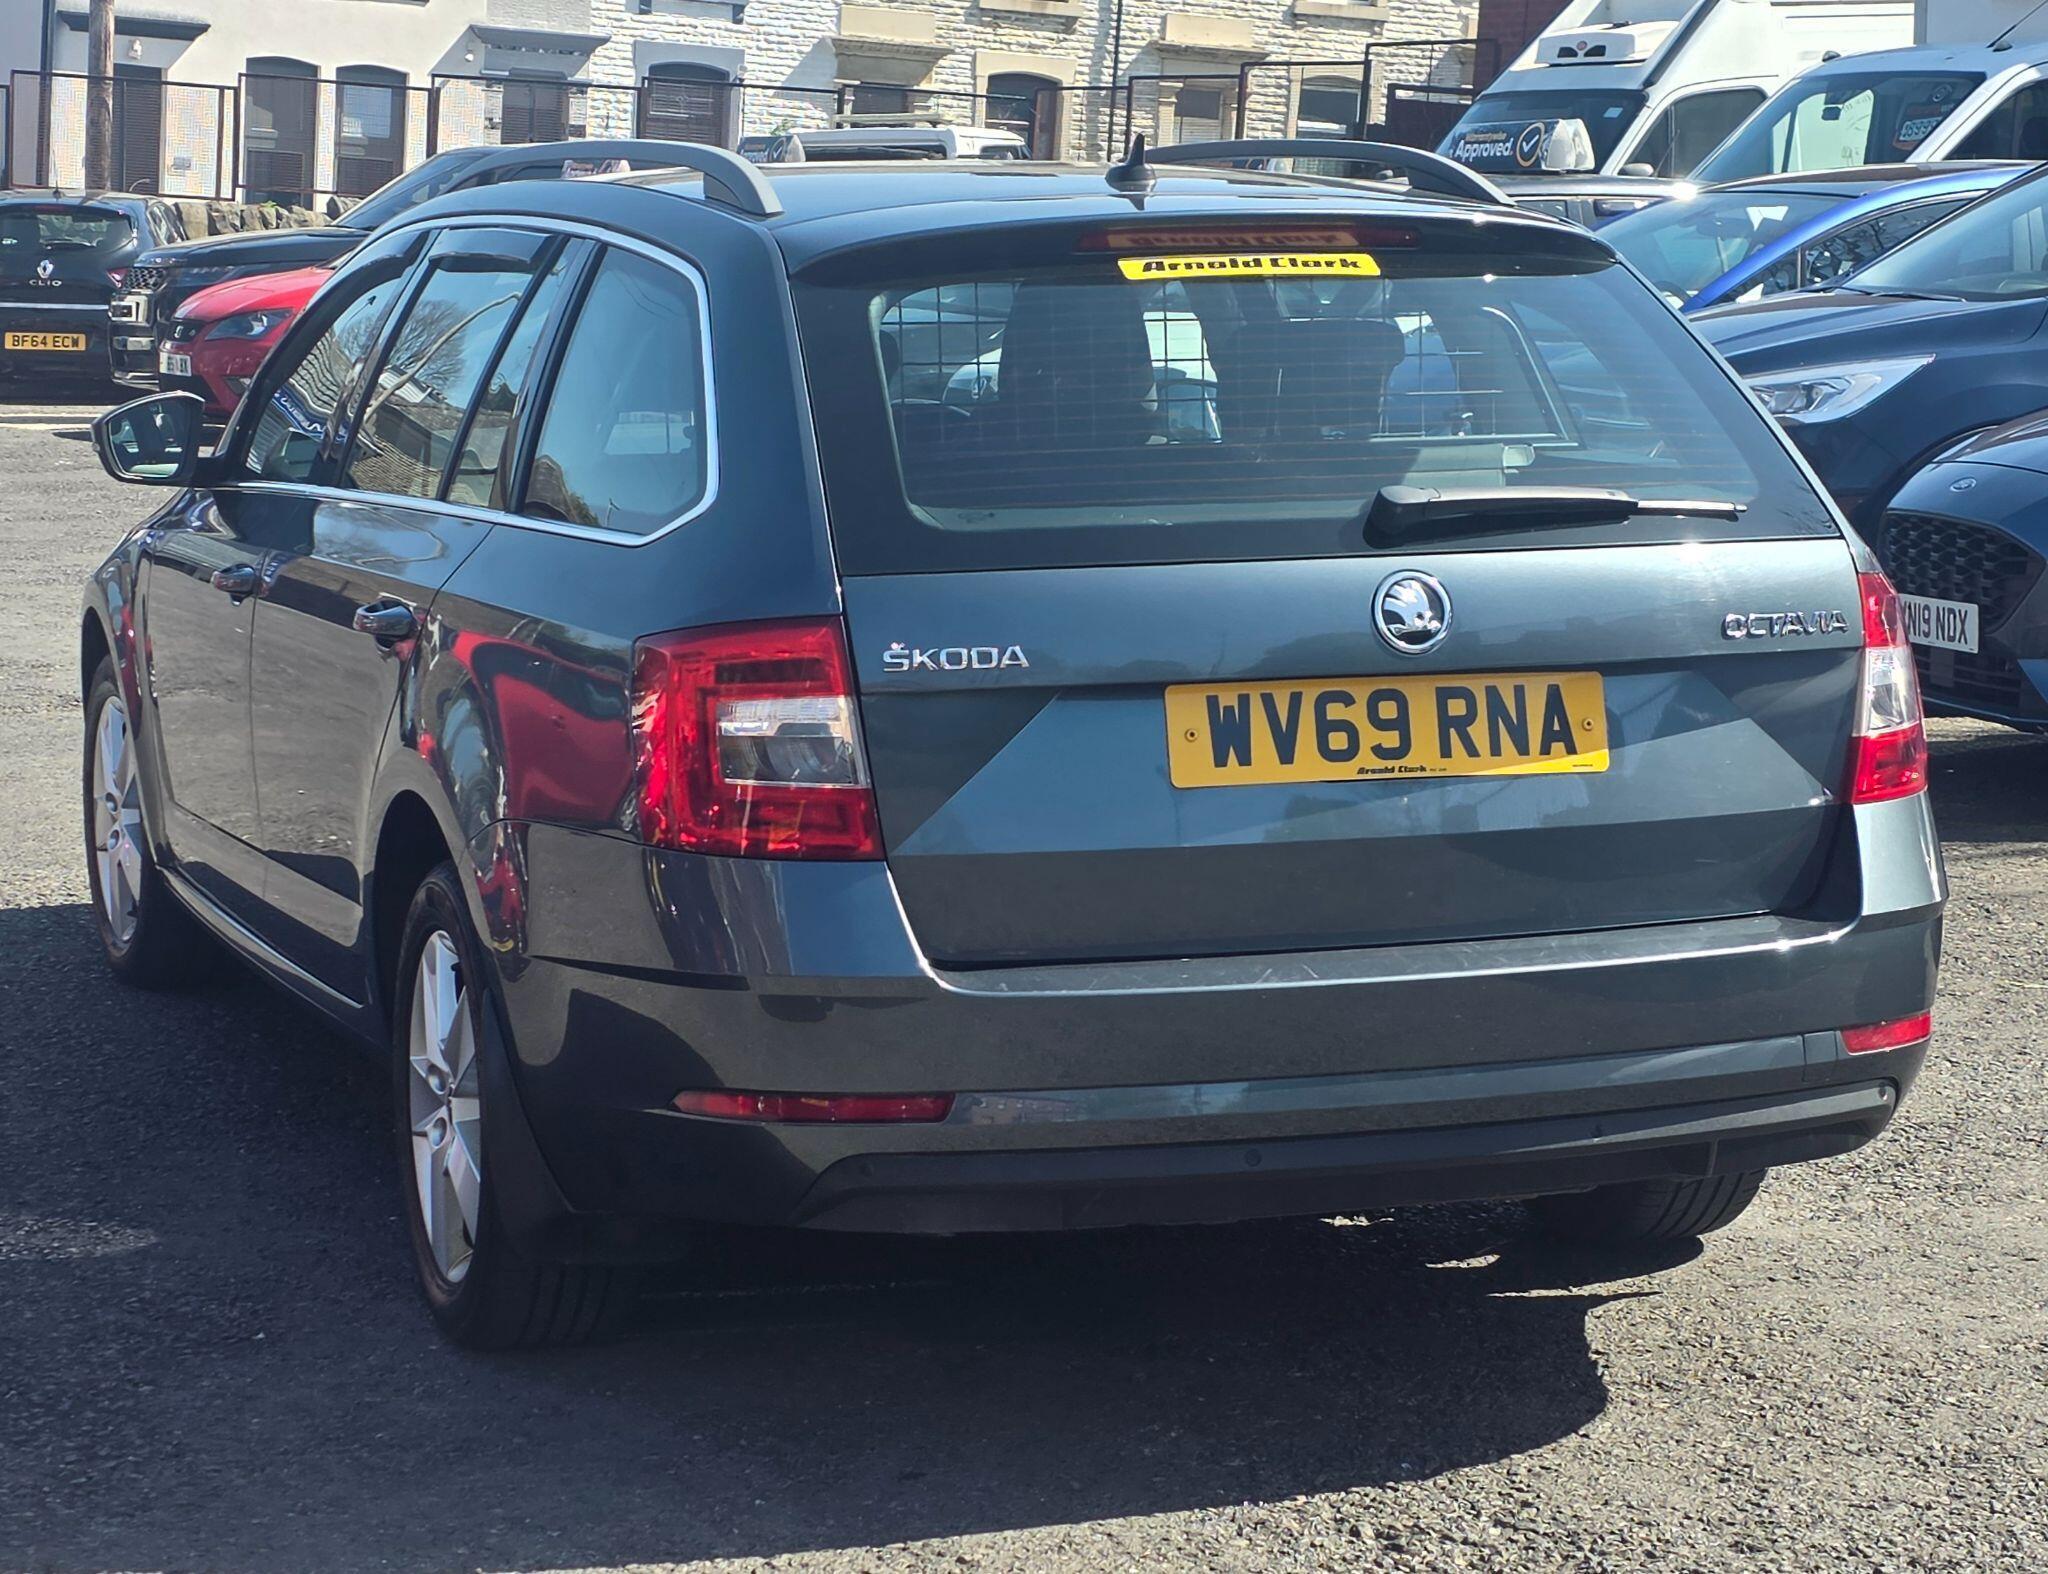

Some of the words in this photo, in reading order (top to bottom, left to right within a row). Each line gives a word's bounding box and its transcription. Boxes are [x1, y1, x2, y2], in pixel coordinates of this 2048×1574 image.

[1142, 257, 1263, 272] Arnold
[1270, 257, 1361, 269] Clark
[29, 279, 62, 287] CLIO
[12, 334, 48, 347] BF64
[52, 335, 80, 348] ECW
[1723, 610, 1850, 639] OCTAVIA
[1935, 605, 1968, 645] NDX
[882, 642, 1030, 672] ŠKODA
[1205, 687, 1412, 768] WV69
[1434, 683, 1578, 759] RNA
